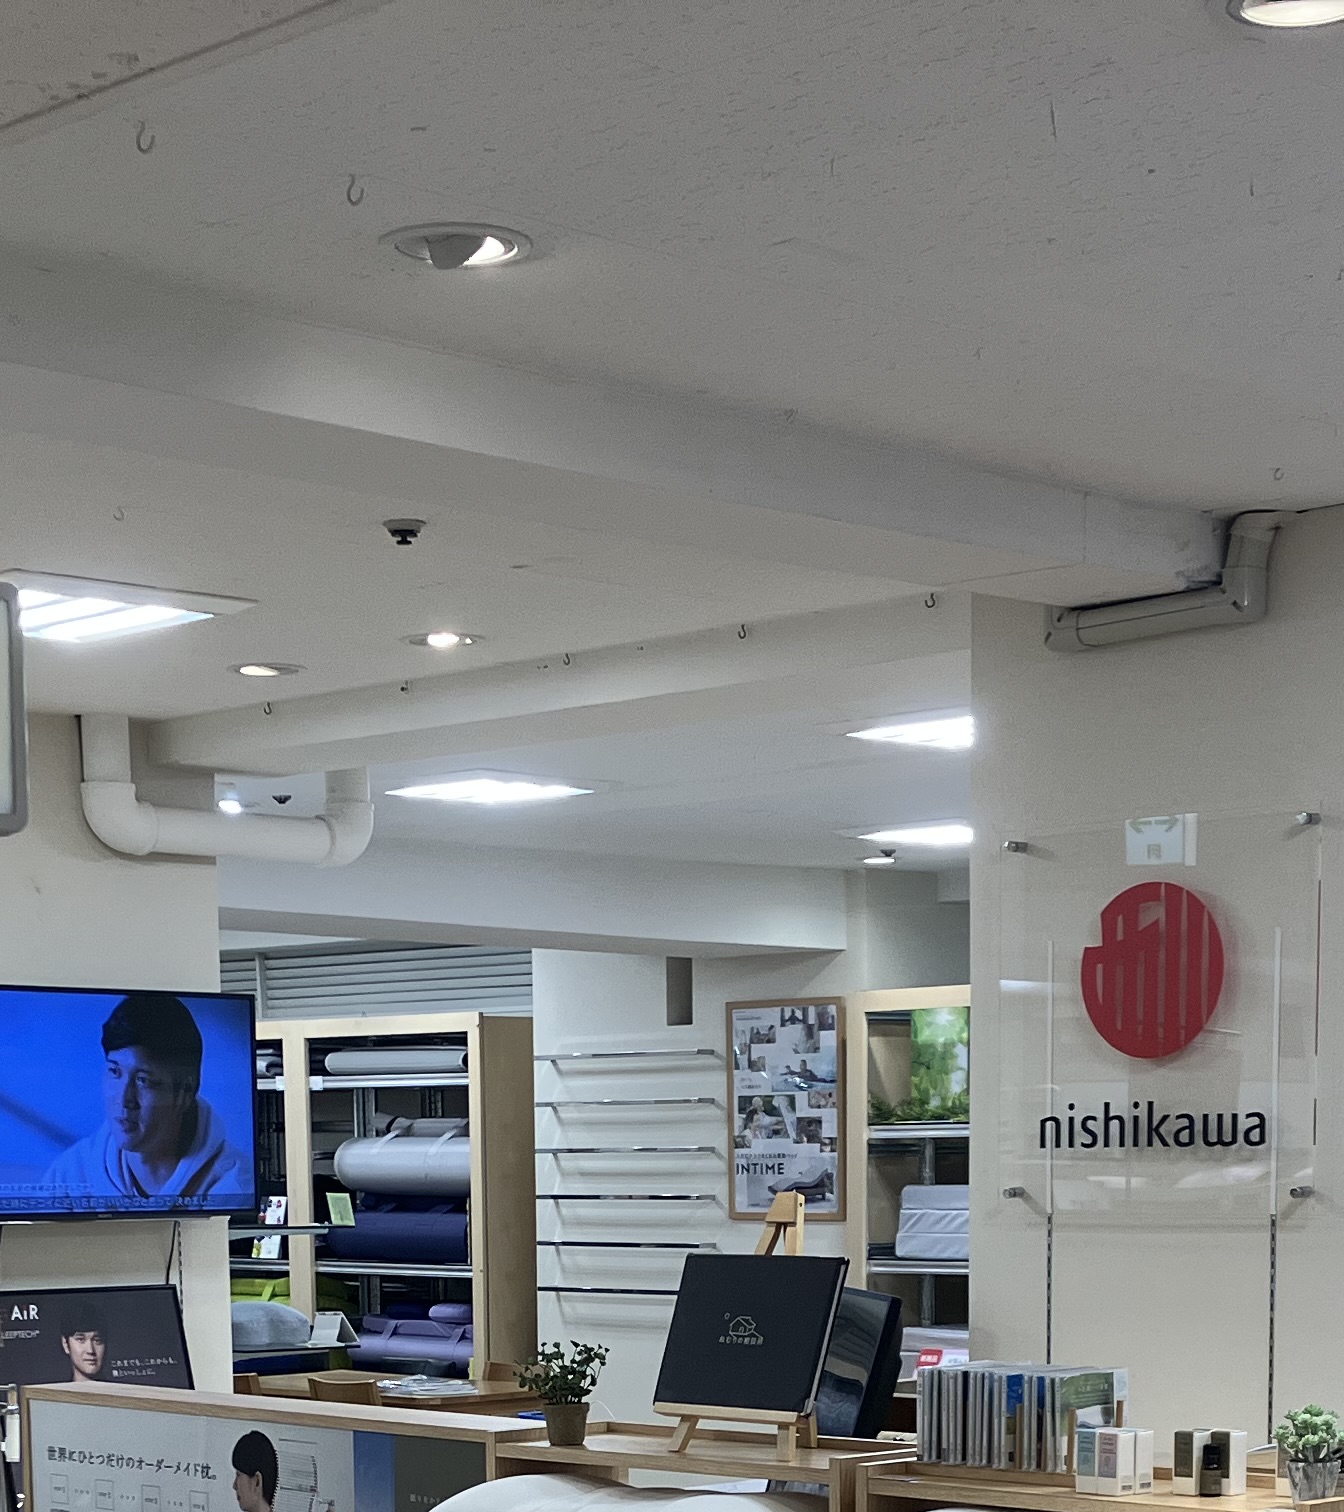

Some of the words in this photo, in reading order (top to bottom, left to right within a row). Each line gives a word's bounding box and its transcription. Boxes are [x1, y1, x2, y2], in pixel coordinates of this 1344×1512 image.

[1039, 1101, 1267, 1149] nishikawa
[736, 1162, 785, 1176] INTIME
[47, 1446, 217, 1481] 世界にひとつだけのオーダーメイド枕。
